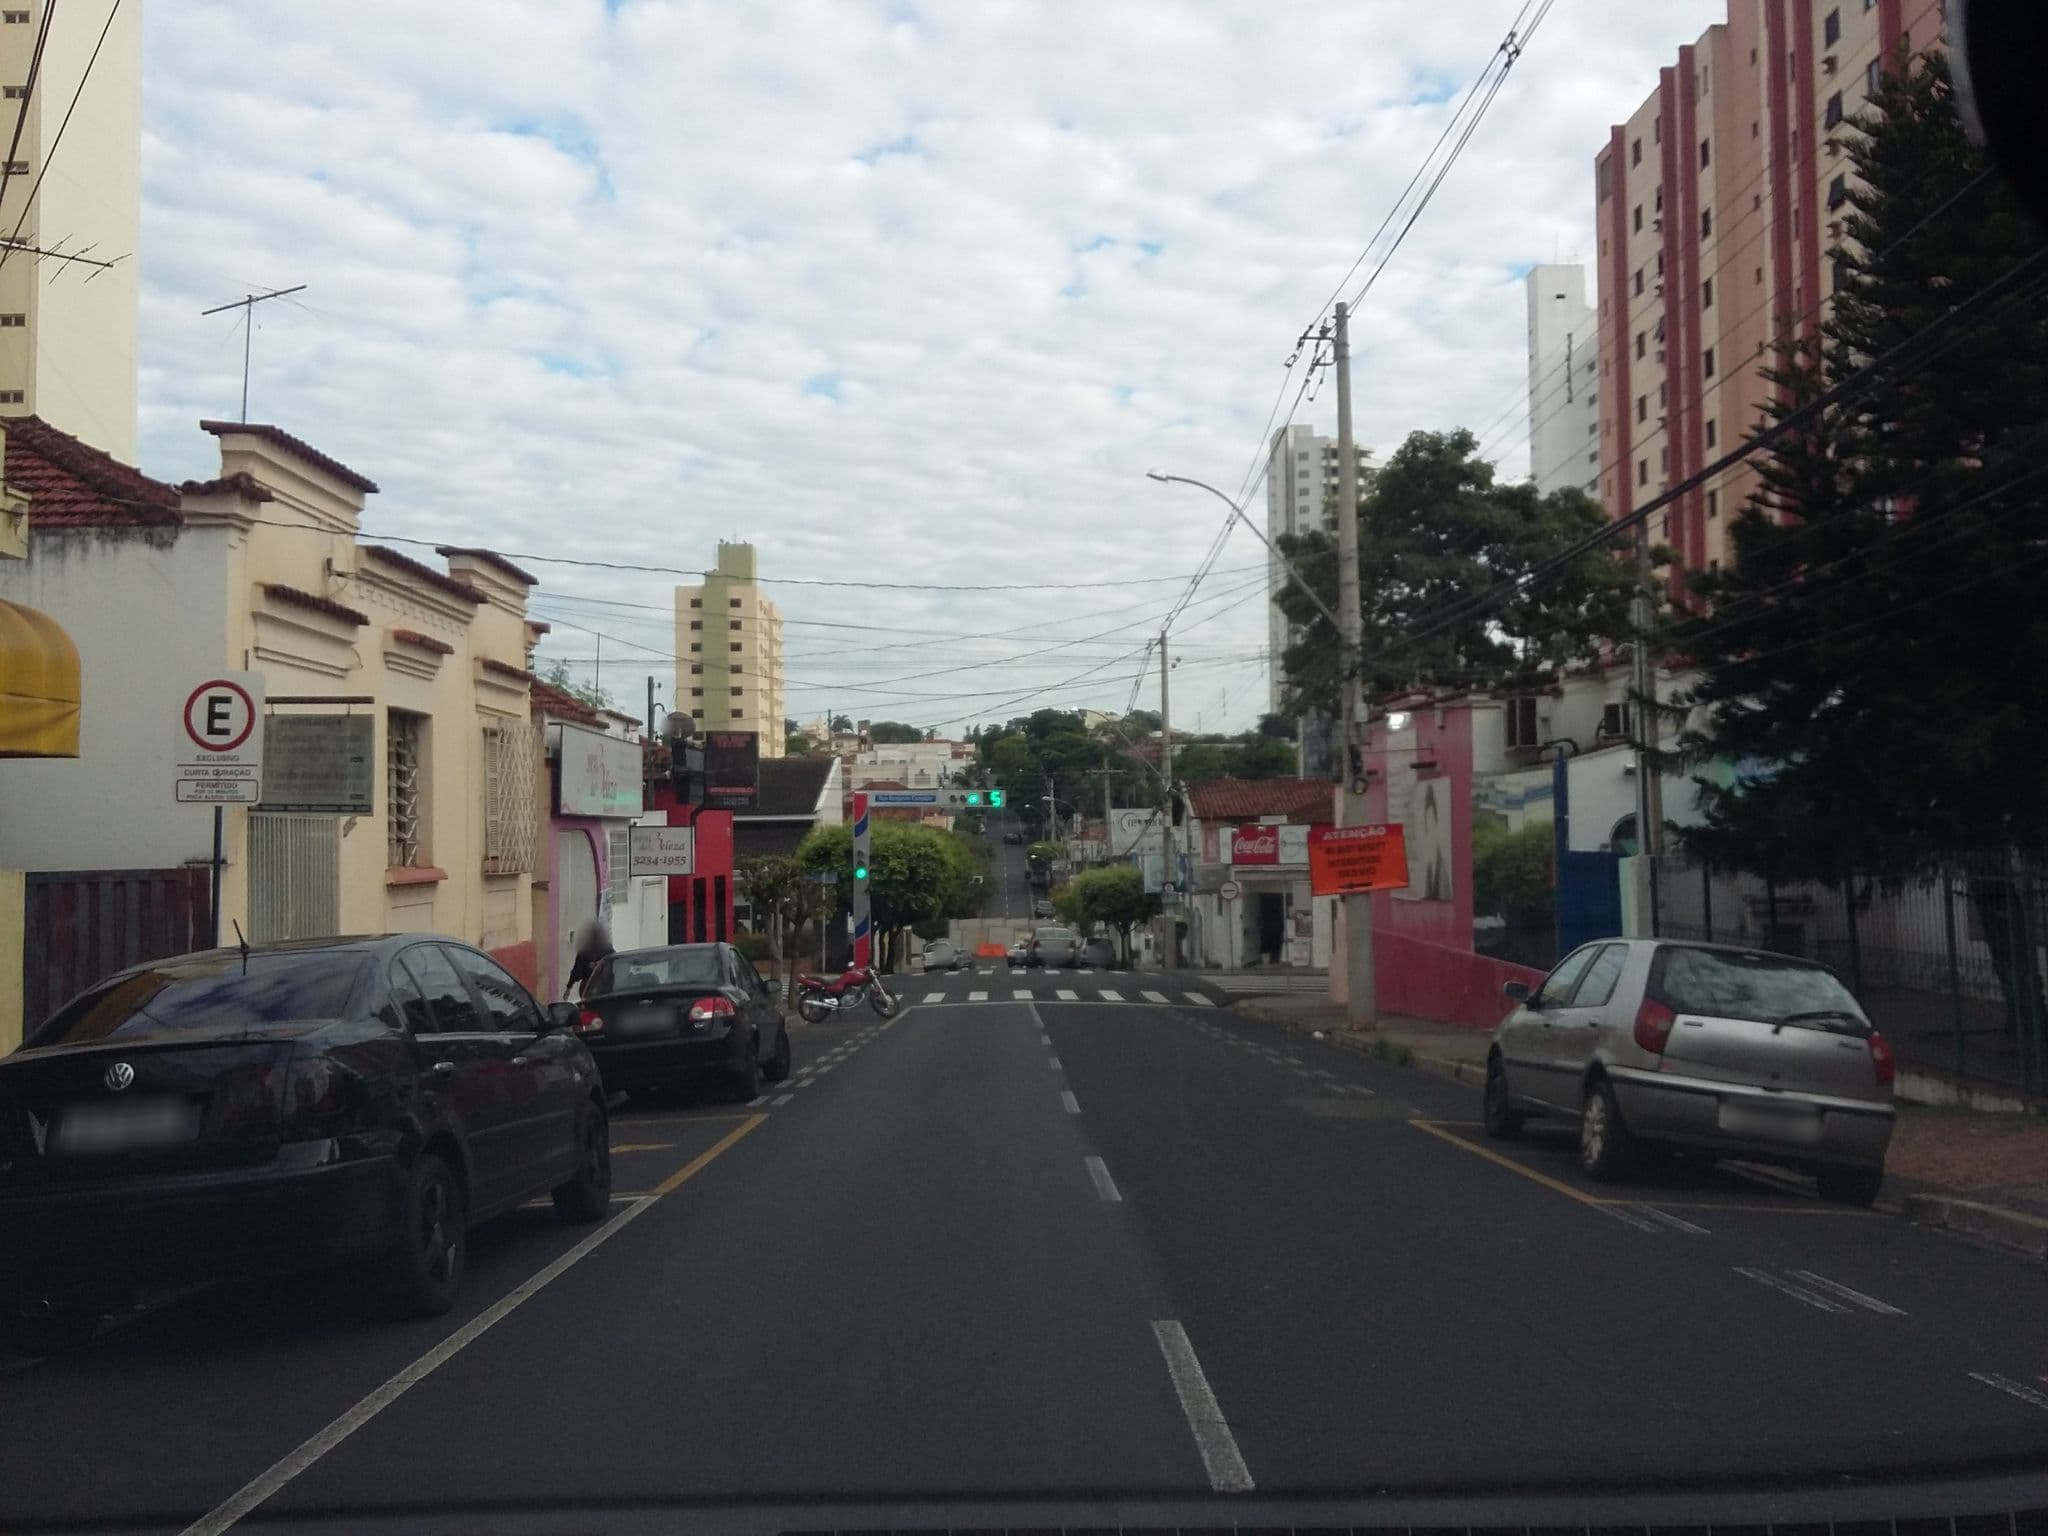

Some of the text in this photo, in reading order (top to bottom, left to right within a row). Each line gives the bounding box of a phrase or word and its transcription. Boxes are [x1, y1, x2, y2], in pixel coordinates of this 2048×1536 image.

[206, 695, 232, 736] E
[196, 754, 240, 762] EXCLUSIVO
[184, 769, 209, 777] CURTA
[989, 789, 1002, 808] 5
[1323, 826, 1386, 840] ATENÇÃO
[1234, 836, 1275, 854] Coca-Cola
[633, 856, 687, 866] 3234-1955
